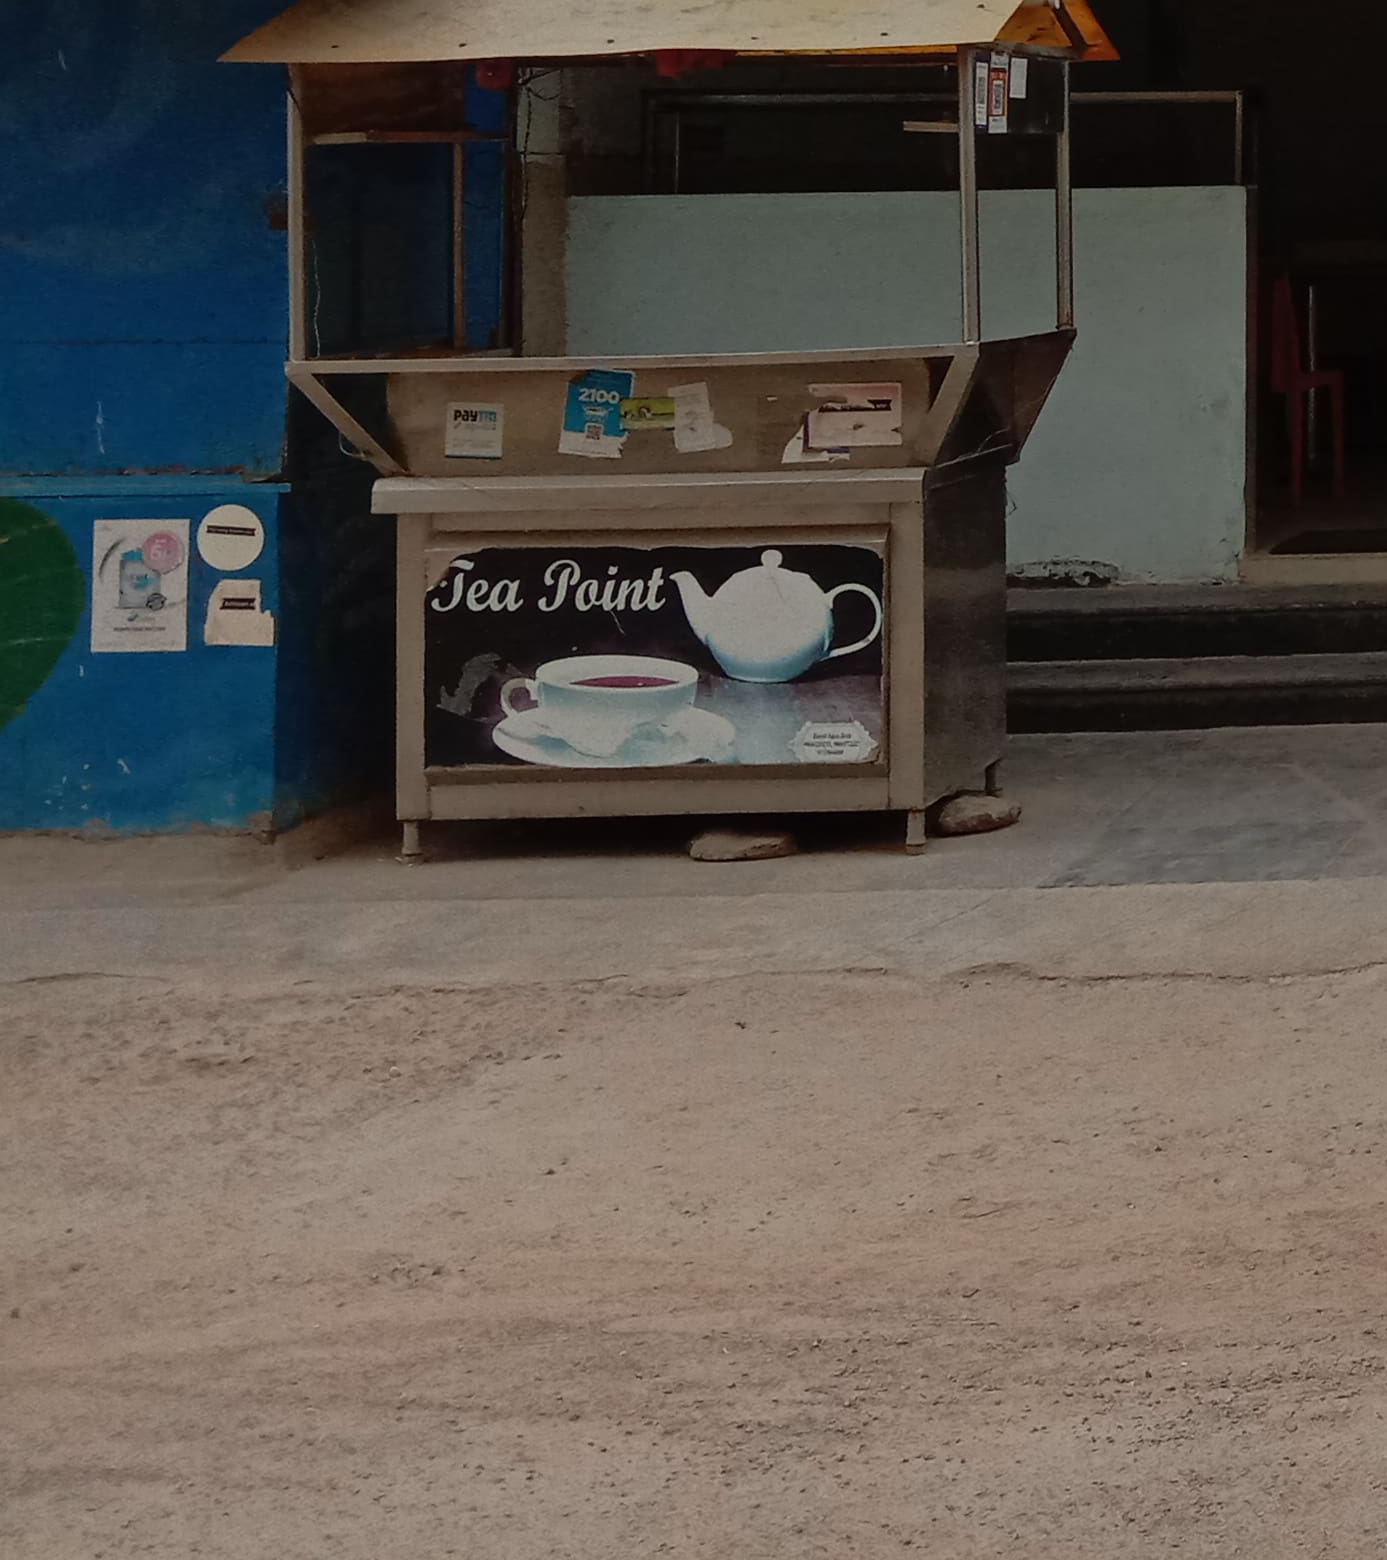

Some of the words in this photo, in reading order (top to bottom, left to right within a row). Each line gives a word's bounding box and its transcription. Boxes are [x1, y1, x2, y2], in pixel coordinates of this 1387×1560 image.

[579, 388, 620, 405] 2100
[431, 559, 524, 612] Tea
[538, 559, 666, 612] Point
